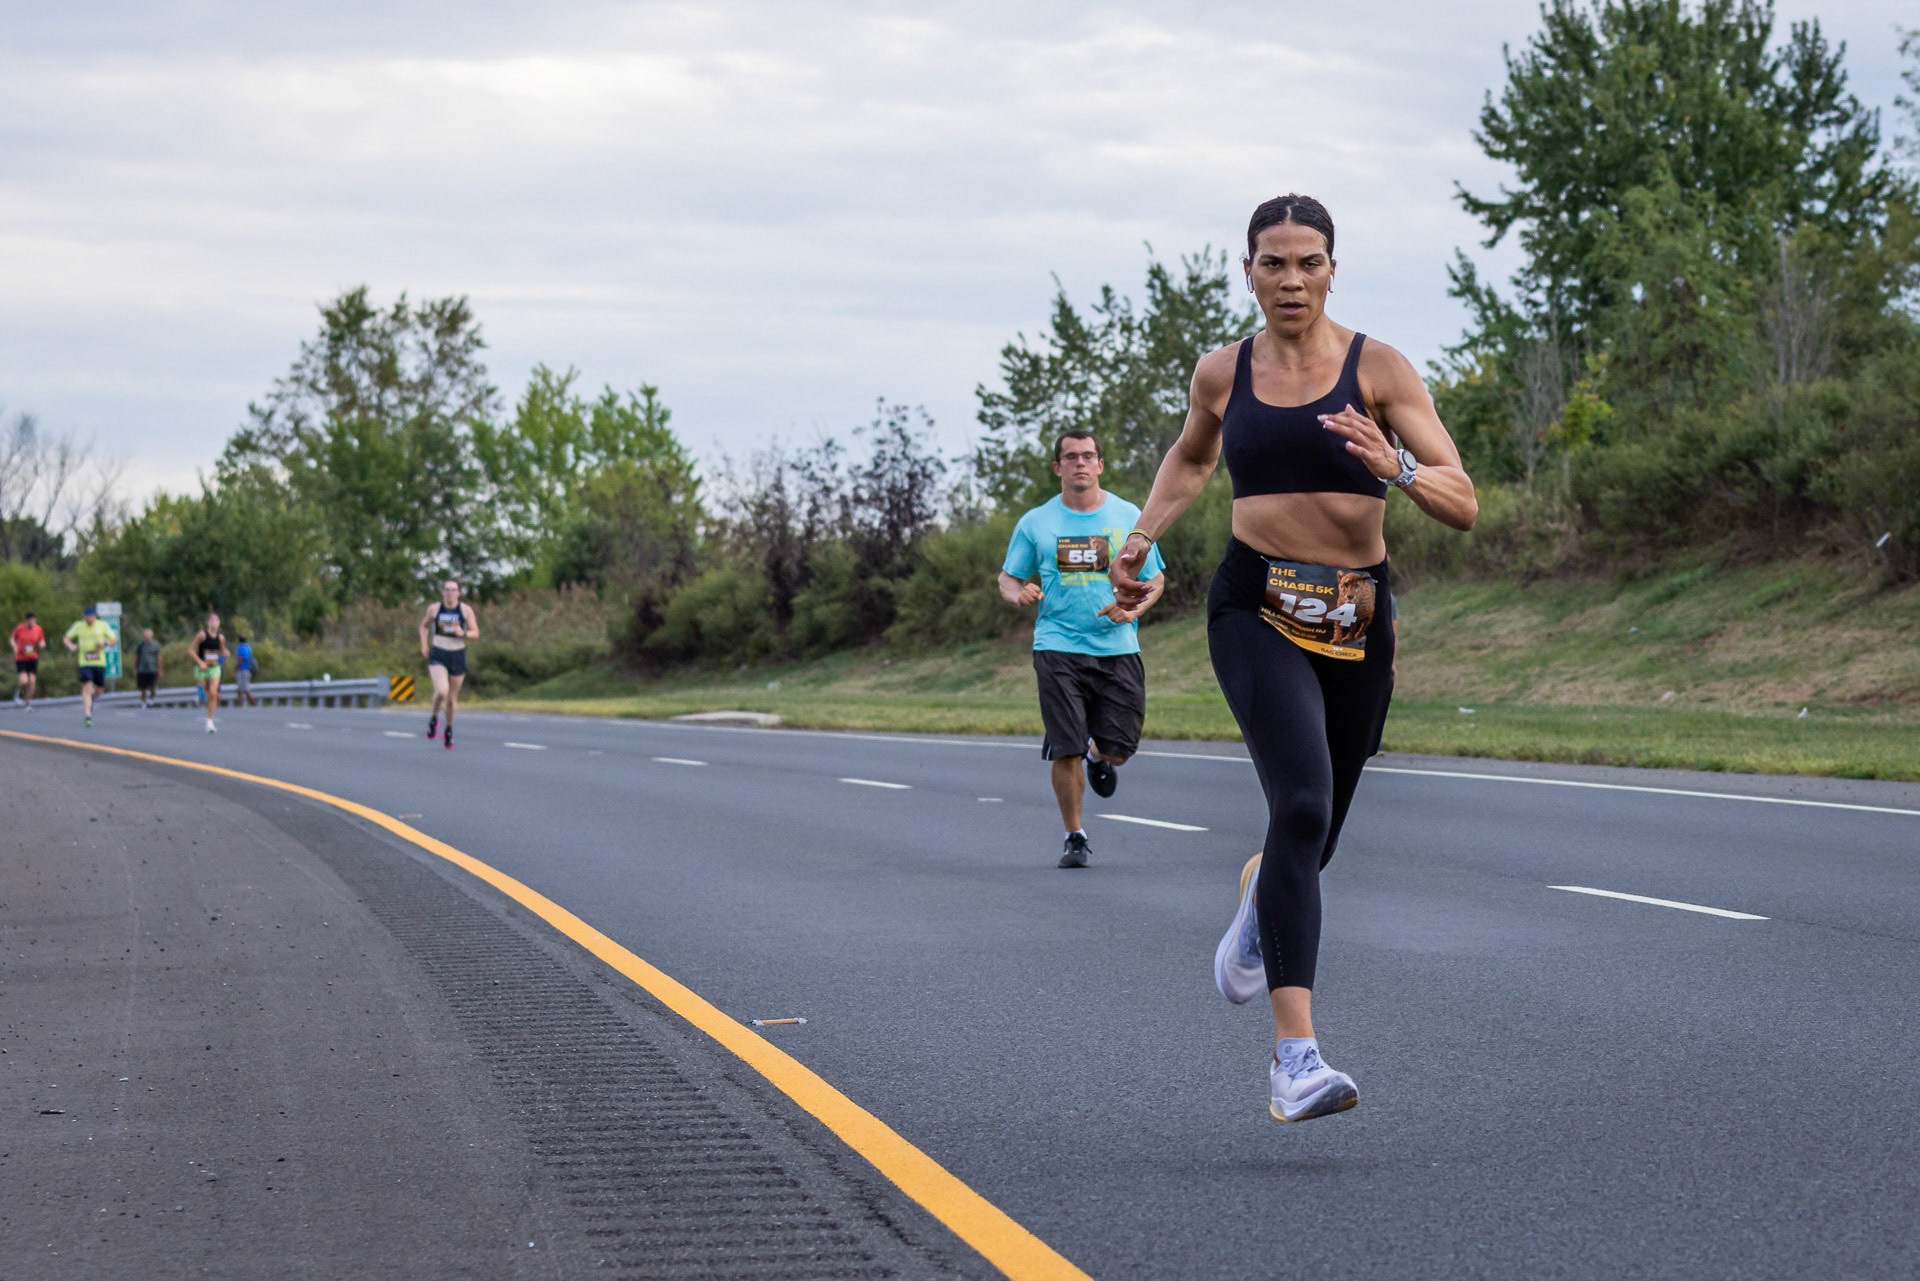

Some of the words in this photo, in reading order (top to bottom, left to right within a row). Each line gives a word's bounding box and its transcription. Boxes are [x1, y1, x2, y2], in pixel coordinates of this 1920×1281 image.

[1270, 567, 1297, 577] THE
[1269, 578, 1314, 592] CHASE
[1279, 592, 1358, 627] 124
[1320, 647, 1334, 655] BAG
